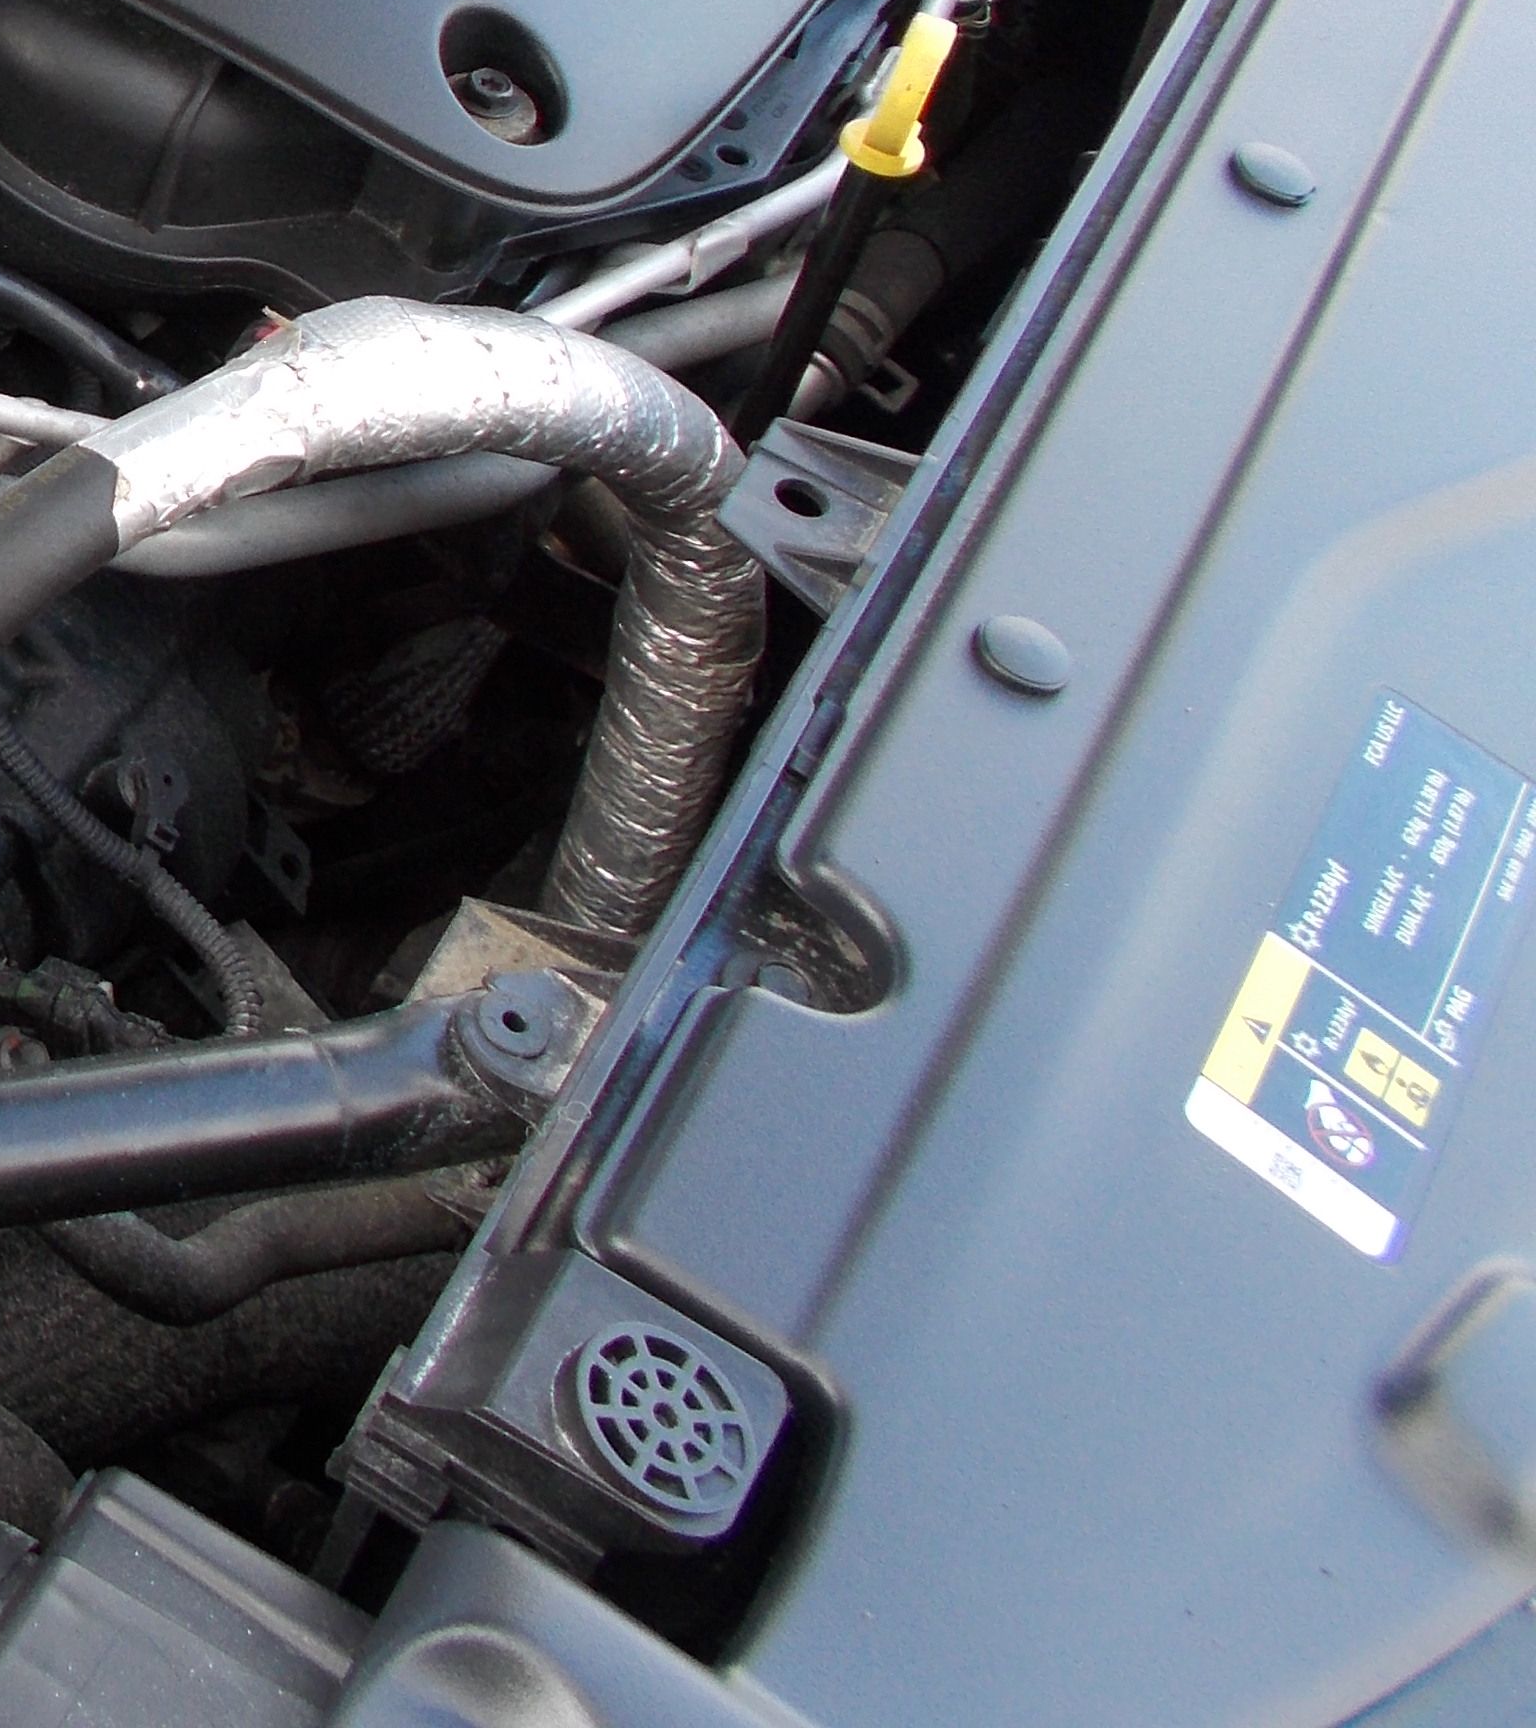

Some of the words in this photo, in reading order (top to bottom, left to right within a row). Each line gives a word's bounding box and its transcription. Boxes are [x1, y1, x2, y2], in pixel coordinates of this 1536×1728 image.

[1362, 738, 1388, 768] FCA
[1303, 858, 1352, 924] R-1234yf
[1361, 888, 1397, 936] SINGLE
[1384, 865, 1405, 890] A/C
[1408, 884, 1434, 910] A/C
[1394, 909, 1424, 946] DUAL
[1444, 984, 1477, 1023] PAG
